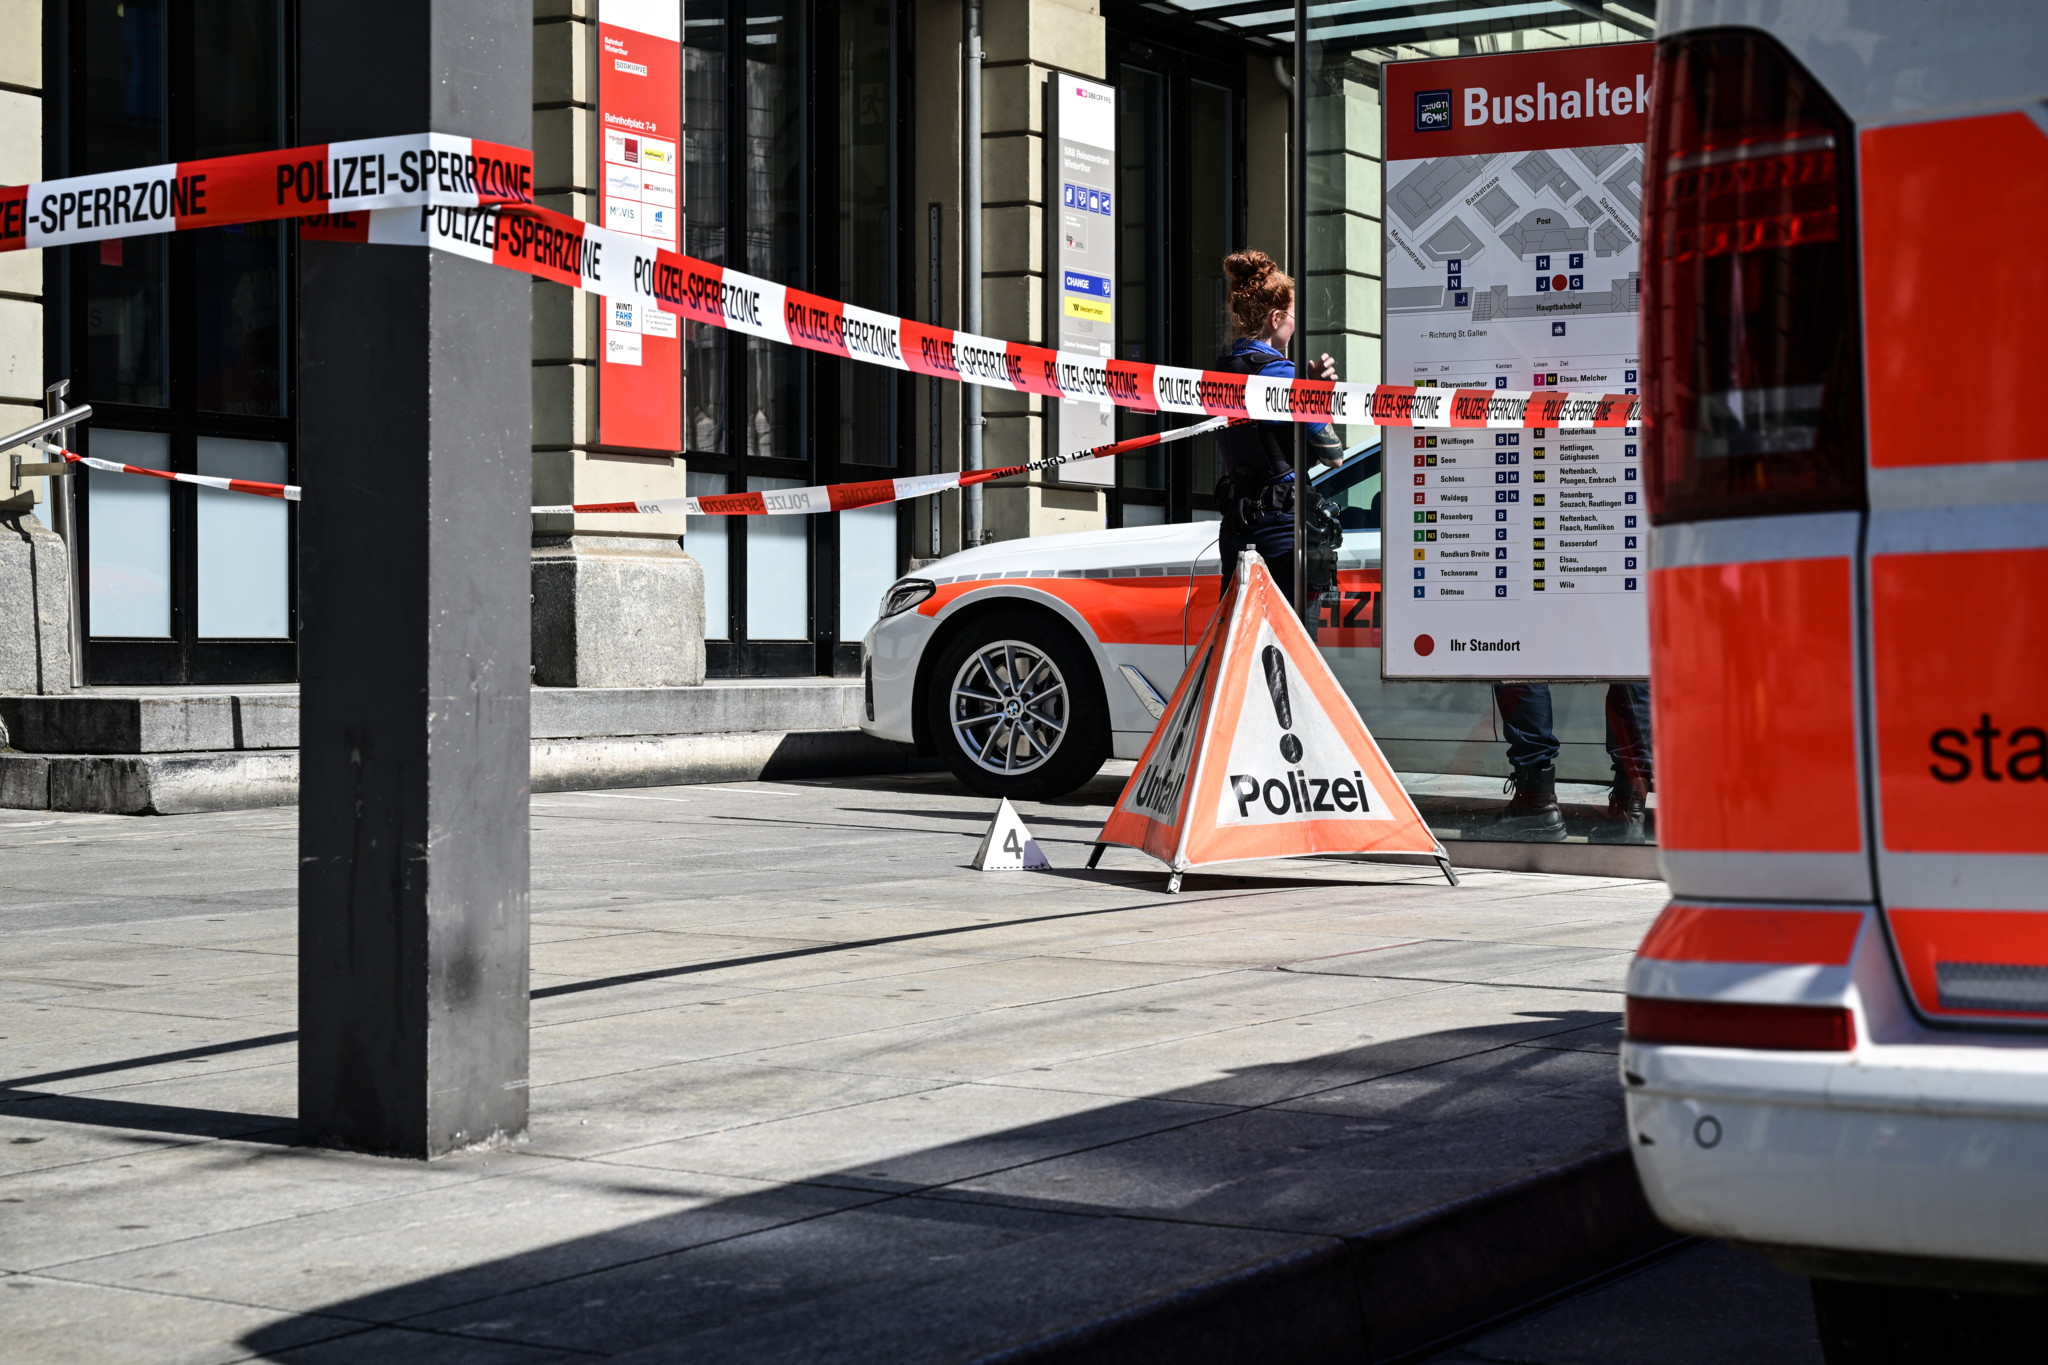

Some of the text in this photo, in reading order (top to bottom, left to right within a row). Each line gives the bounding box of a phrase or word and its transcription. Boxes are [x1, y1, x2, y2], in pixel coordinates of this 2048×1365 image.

[1088, 92, 1096, 100] SBB
[604, 112, 645, 130] Bahnhofplatz
[1064, 146, 1076, 157] SBB
[1064, 158, 1091, 173] Winterthur
[277, 148, 531, 205] POLIZEI-SPERRZONE
[1465, 176, 1500, 207] Bankstrasse
[1536, 217, 1551, 225] Post
[1599, 197, 1641, 243] Stadthausstrasse
[1390, 229, 1427, 271] Museumstrasse
[1450, 262, 1458, 271] M
[1539, 259, 1547, 267] H
[1573, 257, 1579, 266] F
[1066, 276, 1089, 289] CHANGE
[1451, 279, 1458, 288] N
[1540, 280, 1546, 288] J
[1572, 278, 1580, 287] G
[634, 256, 762, 327] POLIZEI-SPERRZONE
[616, 302, 632, 312] WINTI
[1536, 302, 1582, 312] Hauptbahnhof
[616, 310, 632, 321] FAHR
[787, 302, 900, 361] POLIZEI-SPERRZONE
[1428, 329, 1488, 341] Richtung St. Gallen
[921, 336, 1026, 385] POLIZEI-SPERRZONE
[1044, 361, 1138, 401] POLIZEI-SPERRZONE
[1440, 380, 1487, 388] Oberwinterthur
[1159, 377, 1248, 411] POLIZEI-SPERRZONE
[1265, 386, 1347, 417] POLIZEI-SPERRZONE
[1364, 393, 1441, 420] POLIZEI-SPERRZONE
[1456, 397, 1530, 421] POLIZEI-SPERRZONE
[1542, 400, 1615, 421] POLIZEI-SPERRZONE
[1559, 428, 1597, 436] Bruderhaus
[1440, 438, 1474, 446] Wülflingen
[1559, 444, 1594, 452] Hettlingen,
[1559, 454, 1599, 462] Gütighausen
[1440, 494, 1468, 502] Waldegg
[1559, 491, 1594, 499] Rosenberg,
[1588, 500, 1622, 508] Reutlingen
[1440, 513, 1473, 521] Rosenberg
[1628, 518, 1633, 526] H
[1559, 524, 1583, 532] Flaach,
[1559, 565, 1607, 573] Wiesendangen
[1559, 581, 1575, 589] Wila
[1450, 639, 1520, 652] Ihr Standort
[1136, 764, 1185, 816] Unfall
[1230, 769, 1370, 817] Polizei
[1003, 829, 1023, 860] 4
